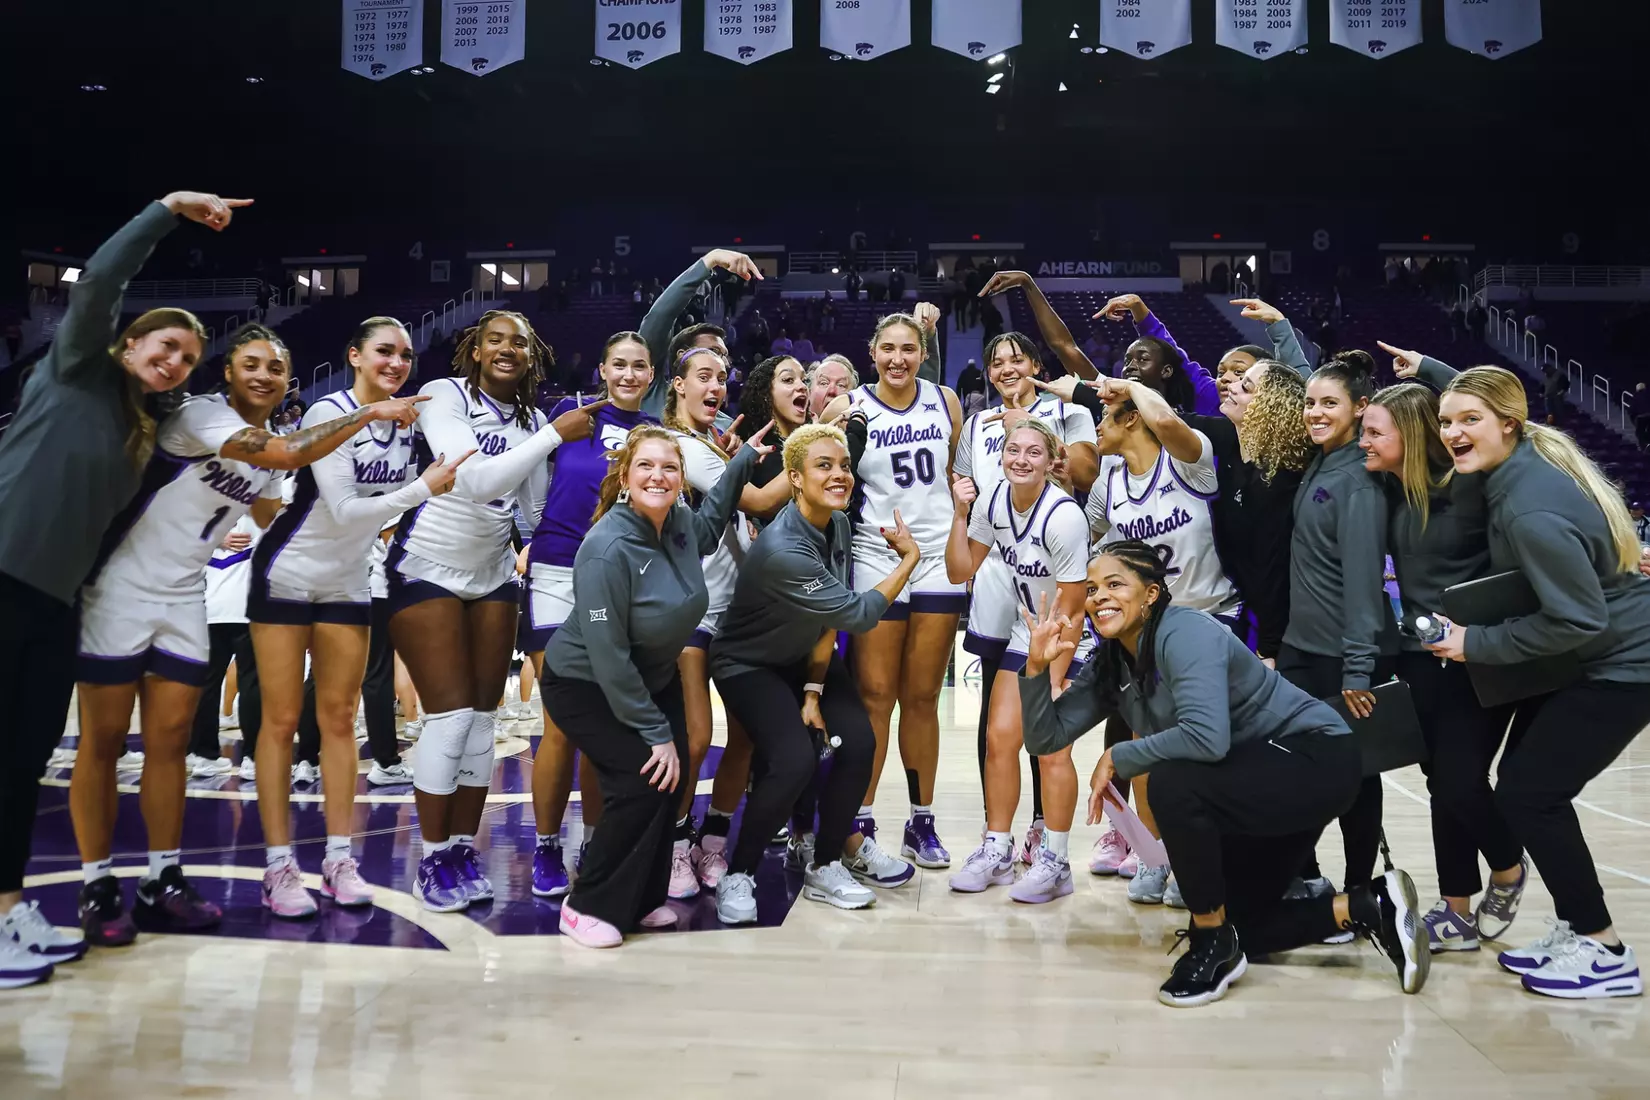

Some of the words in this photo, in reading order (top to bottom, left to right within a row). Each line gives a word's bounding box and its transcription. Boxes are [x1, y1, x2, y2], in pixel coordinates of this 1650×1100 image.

[456, 5, 479, 15] 1999
[487, 4, 510, 14] 2015
[719, 4, 743, 14] 1977
[753, 3, 777, 12] 1983
[835, 0, 860, 9] 2008
[355, 12, 377, 21] 1972
[387, 10, 409, 19] 1977
[1116, 9, 1141, 18] 2002
[1233, 9, 1258, 18] 1984
[1266, 8, 1292, 18] 2003
[1347, 8, 1372, 17] 2009
[1381, 7, 1406, 17] 2017
[455, 16, 478, 26] 2006
[486, 15, 510, 24] 2018
[719, 15, 743, 25] 1978
[753, 14, 777, 23] 1984
[1233, 20, 1258, 30] 1987
[1266, 20, 1292, 29] 2004
[1347, 19, 1371, 29] 2011
[1381, 19, 1407, 28] 2019
[354, 22, 376, 32] 1973
[386, 21, 408, 30] 1978
[454, 27, 478, 36] 2007
[486, 26, 509, 35] 2023
[606, 20, 667, 41] 2006
[718, 26, 742, 36] 1979
[753, 25, 777, 35] 1987
[354, 32, 376, 42] 1974
[386, 31, 408, 41] 1979
[353, 43, 375, 52] 1975
[385, 42, 407, 52] 1980
[454, 38, 477, 47] 2013
[352, 54, 375, 63] 1976
[614, 235, 631, 256] 5
[1312, 229, 1330, 251] 8
[1562, 232, 1580, 254] 9
[408, 240, 424, 260] 4
[869, 423, 944, 449] Wildcats
[352, 457, 408, 484] Wildcat
[889, 447, 937, 490] 50
[199, 504, 232, 541] 1
[1116, 505, 1193, 541] Wildcats
[995, 539, 1052, 578] Wilcats
